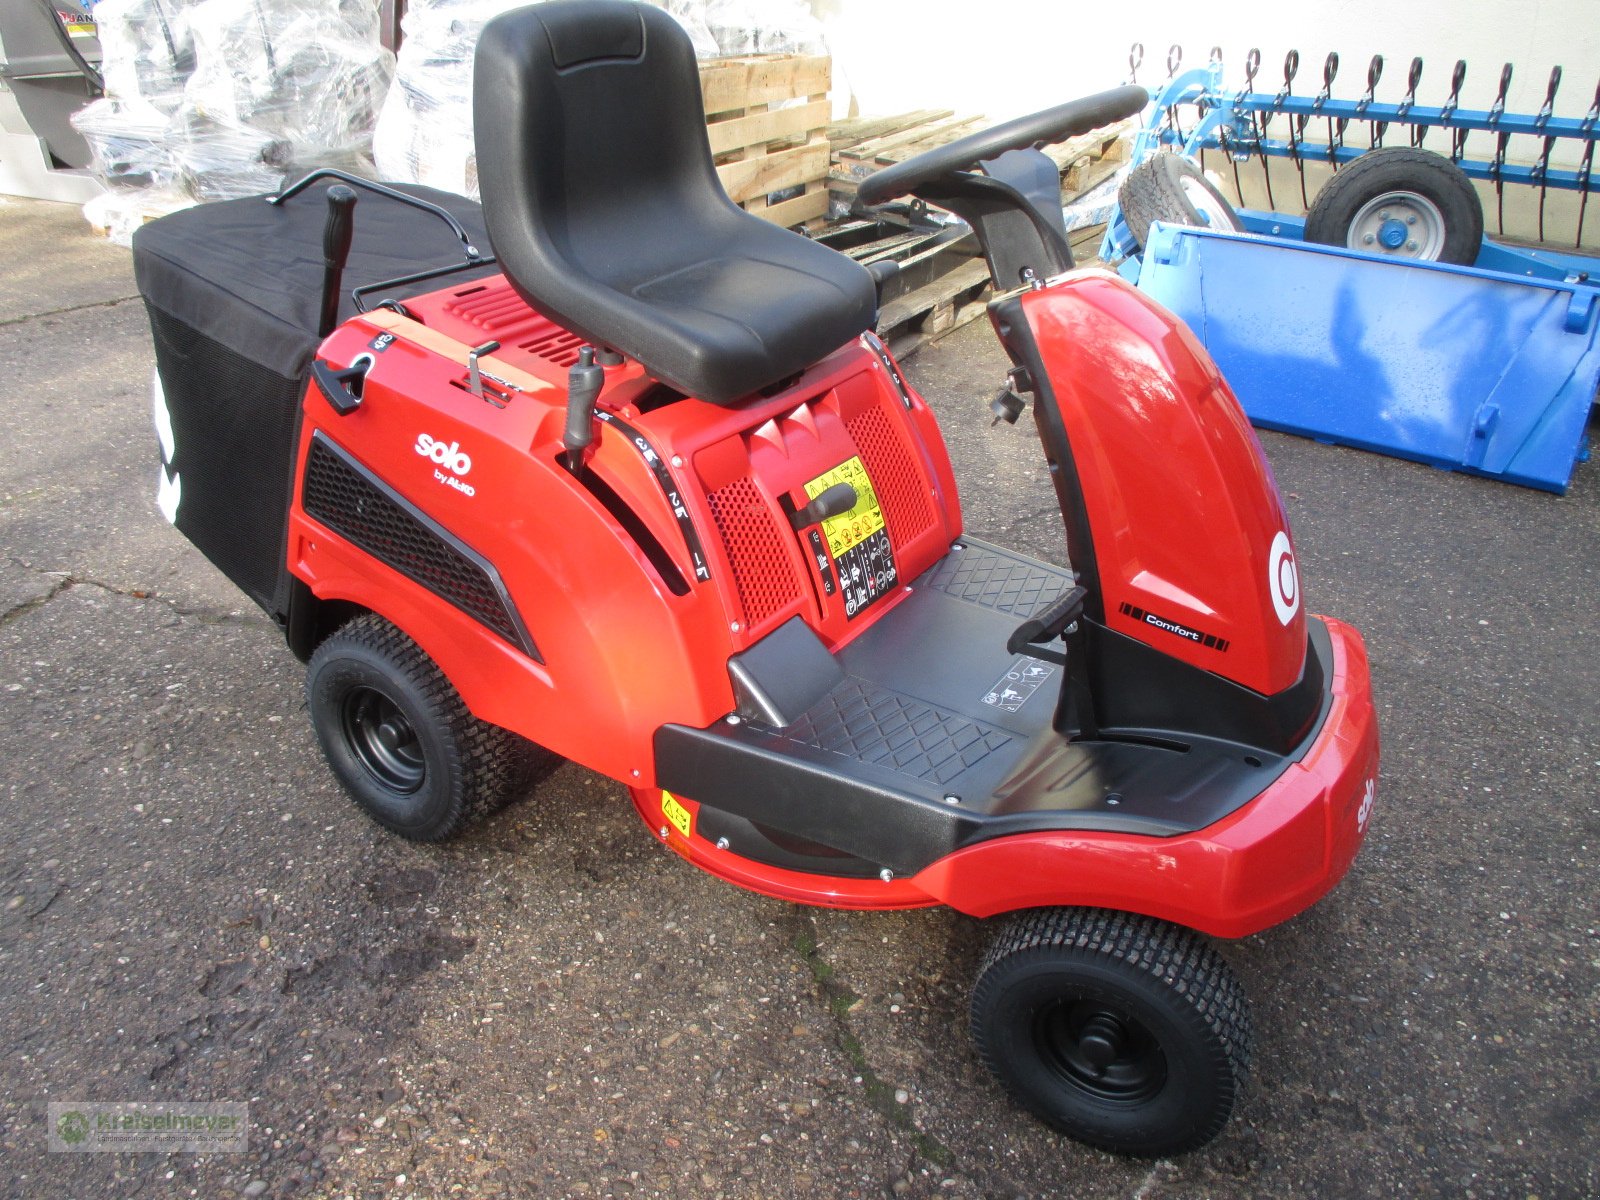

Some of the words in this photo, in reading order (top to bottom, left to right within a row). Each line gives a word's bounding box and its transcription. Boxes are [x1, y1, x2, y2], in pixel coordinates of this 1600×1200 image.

[69, 14, 97, 23] JAN
[414, 433, 472, 476] solo
[433, 468, 448, 484] by
[1146, 614, 1199, 640] Comfort
[1357, 778, 1375, 833] solo
